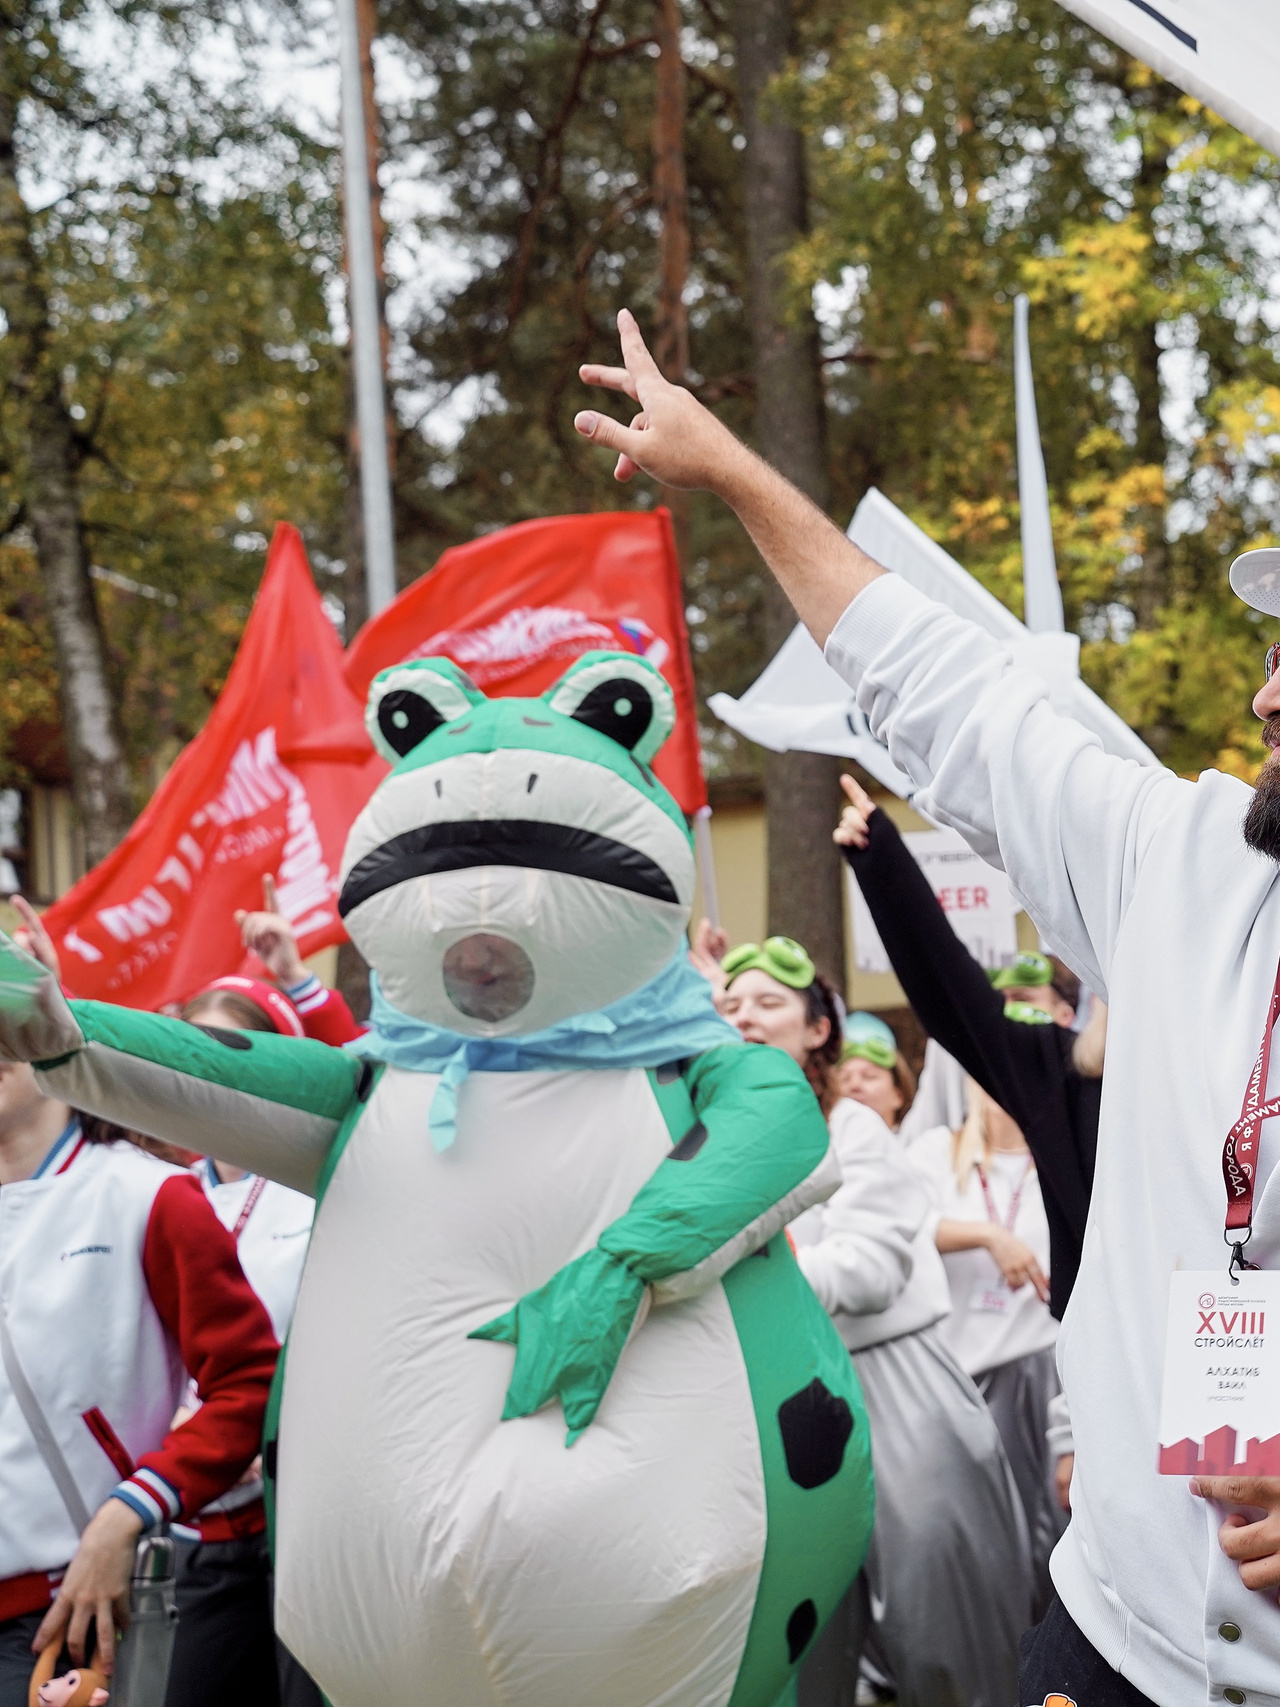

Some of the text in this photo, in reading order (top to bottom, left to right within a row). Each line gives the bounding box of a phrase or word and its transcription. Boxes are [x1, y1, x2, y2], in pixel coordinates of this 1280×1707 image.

[1241, 1142, 1253, 1152] Я
[1226, 1134, 1247, 1198] ГОРОДА
[1196, 1311, 1265, 1335] XVIII
[1194, 1335, 1265, 1348] СТРОЙСЛЁТ
